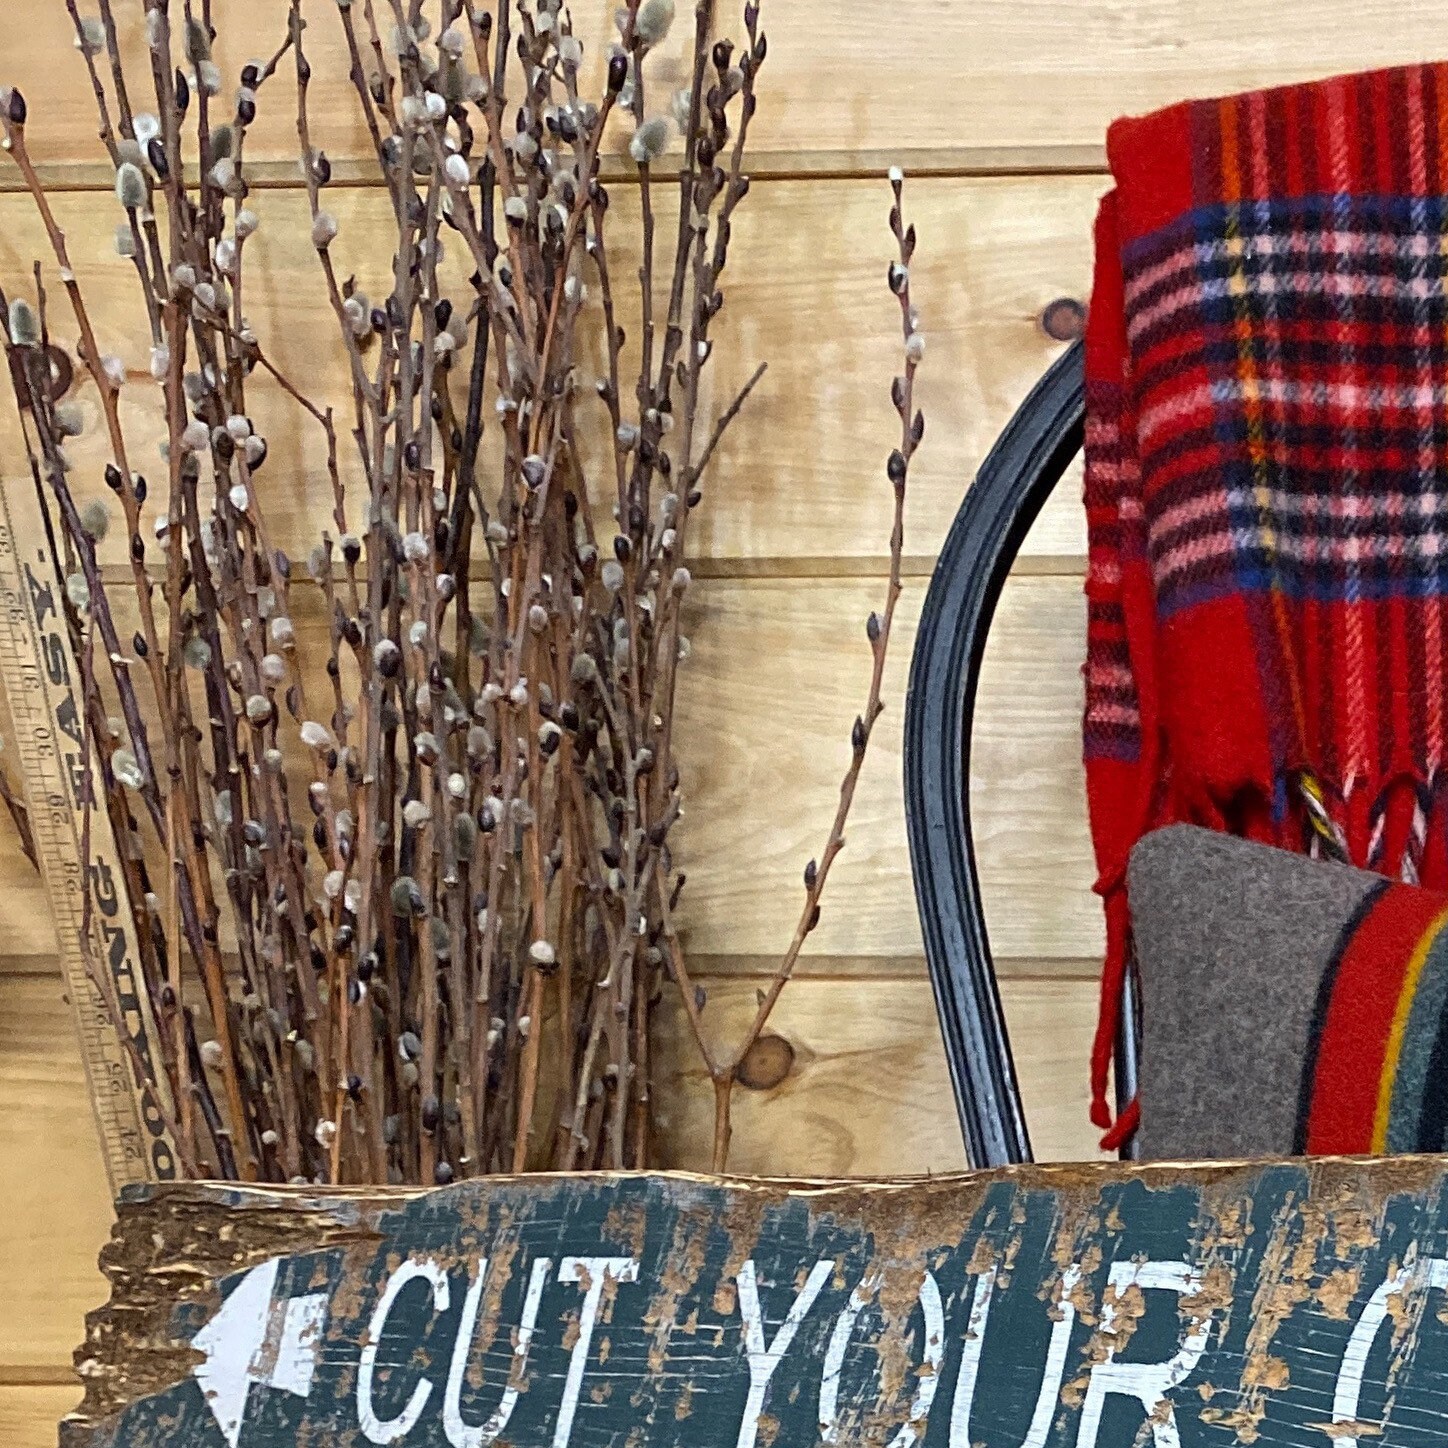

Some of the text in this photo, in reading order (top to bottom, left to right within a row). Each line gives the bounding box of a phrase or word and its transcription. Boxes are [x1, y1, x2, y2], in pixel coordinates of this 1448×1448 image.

[35, 726, 54, 757] 30
[48, 794, 70, 825] 29
[106, 1062, 128, 1093] 25
